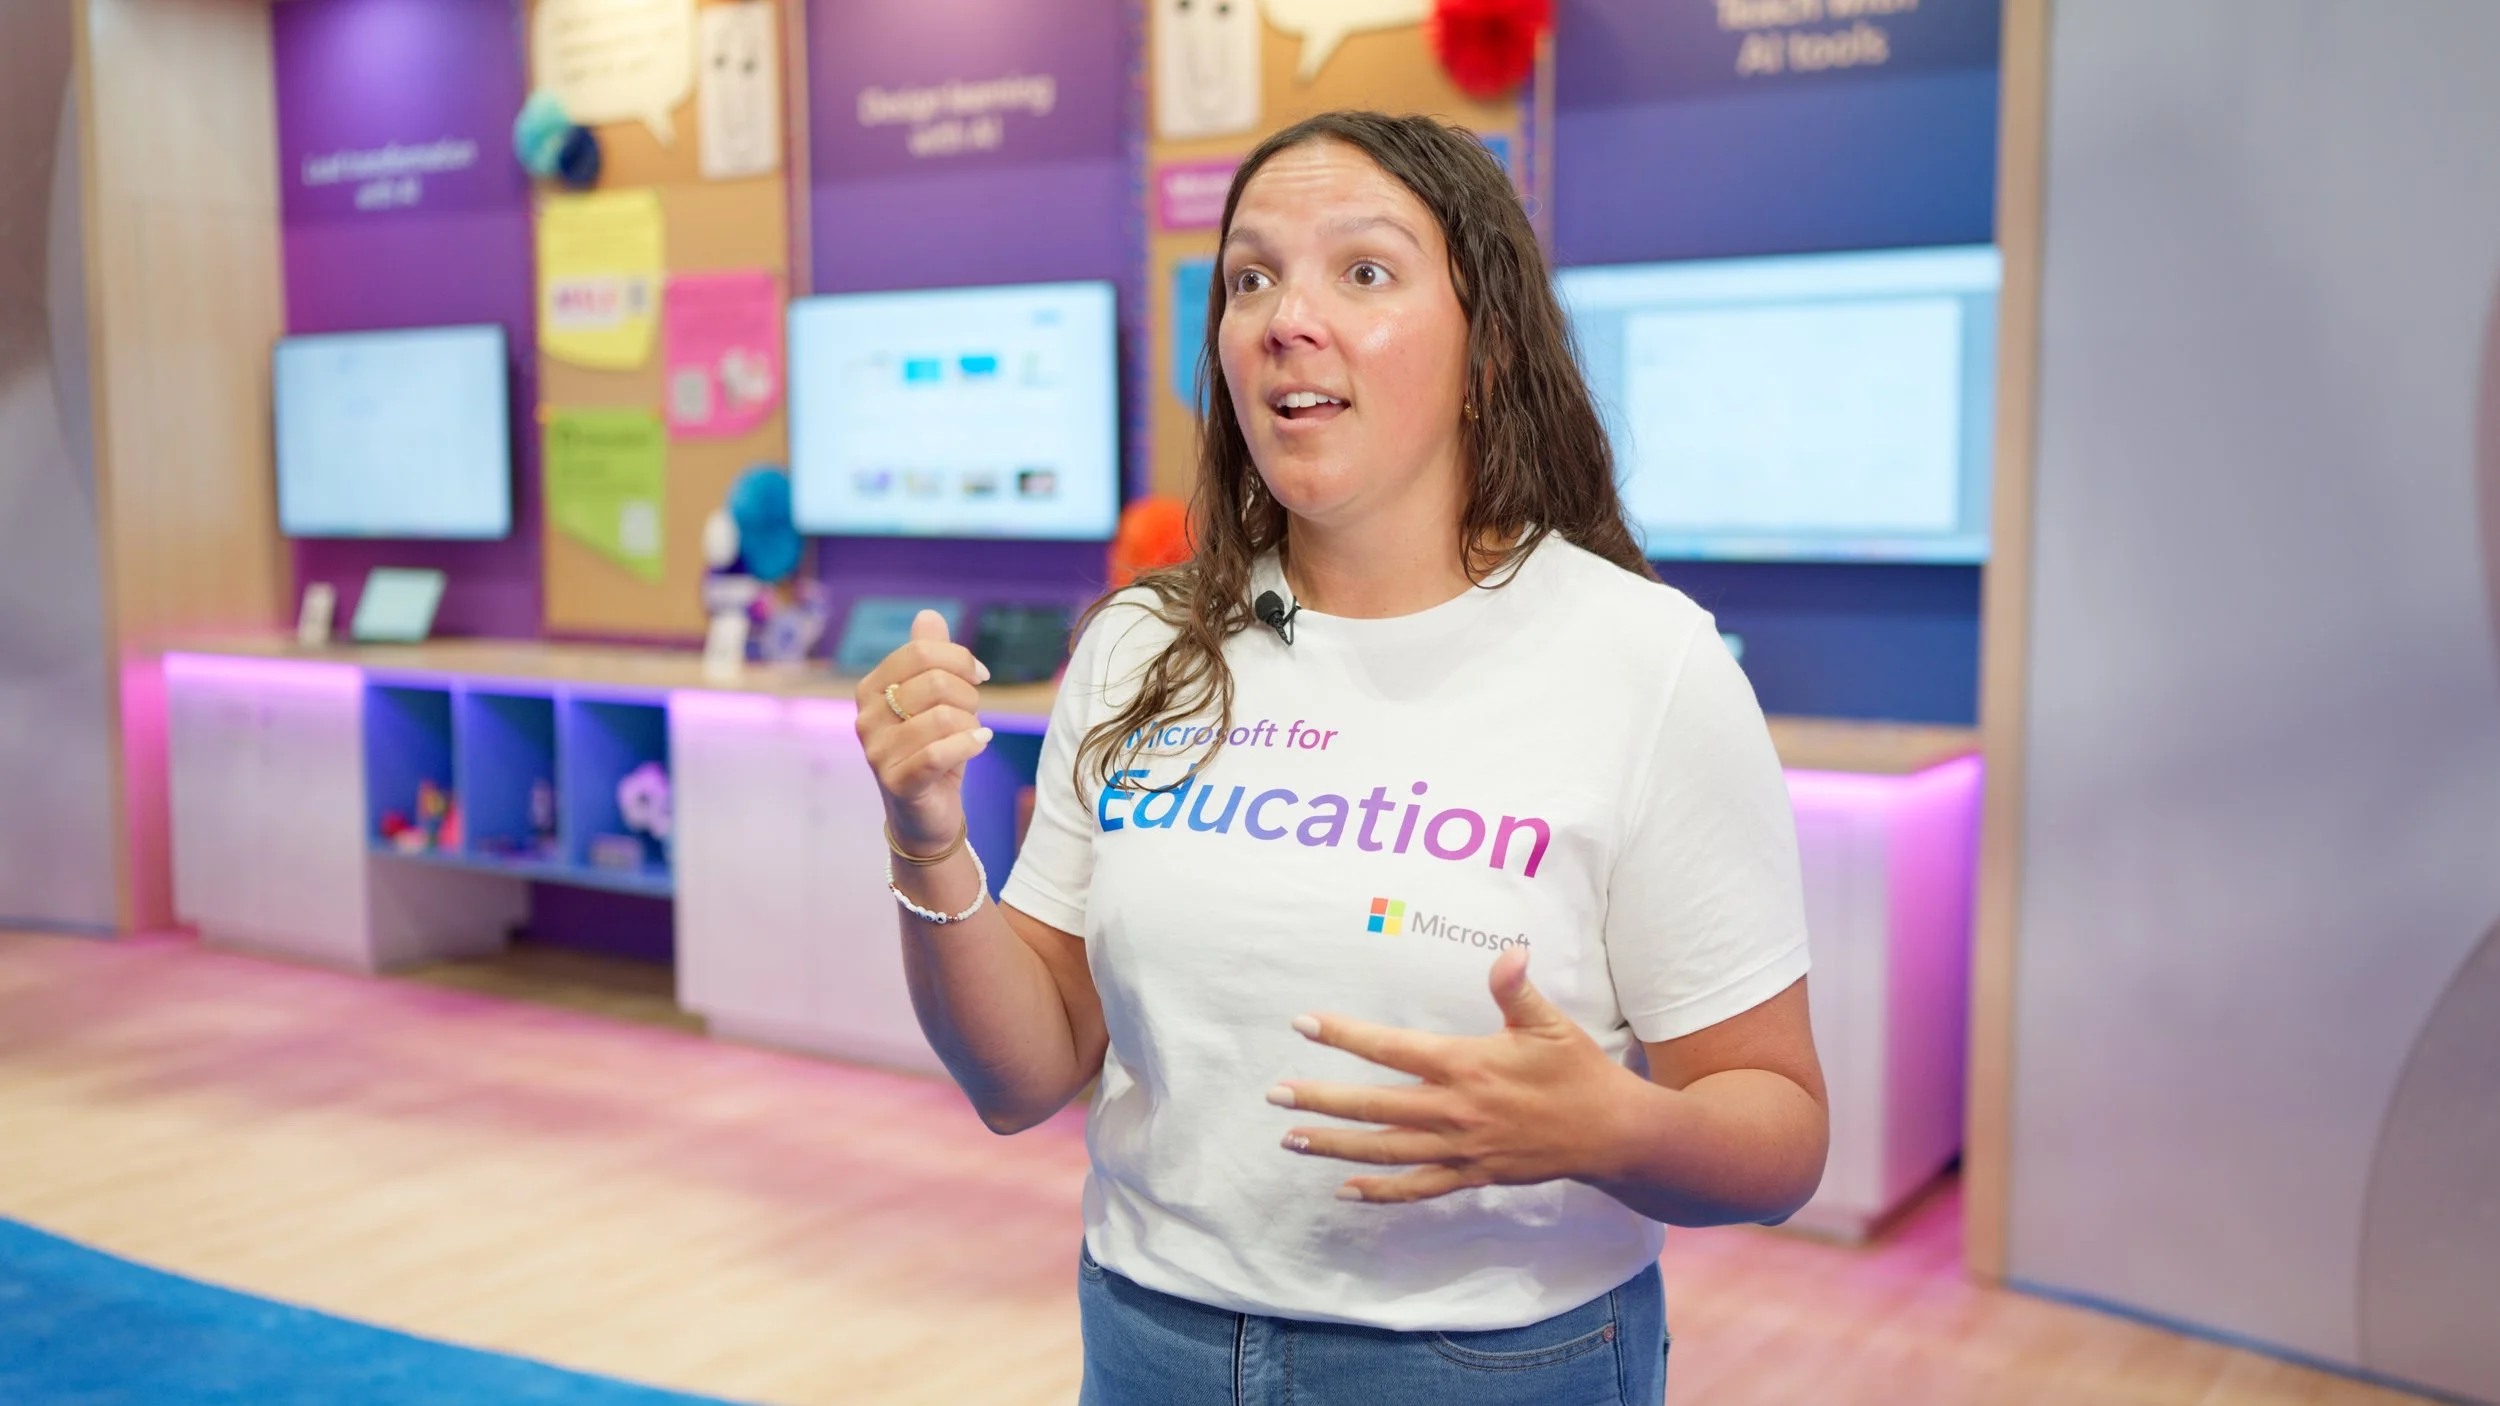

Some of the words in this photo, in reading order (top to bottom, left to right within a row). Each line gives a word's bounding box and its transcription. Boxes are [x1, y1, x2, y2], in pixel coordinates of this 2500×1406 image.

[1736, 32, 1786, 75] AI
[1788, 20, 1889, 71] tools
[1286, 719, 1338, 750] for
[1098, 763, 1551, 878] Education
